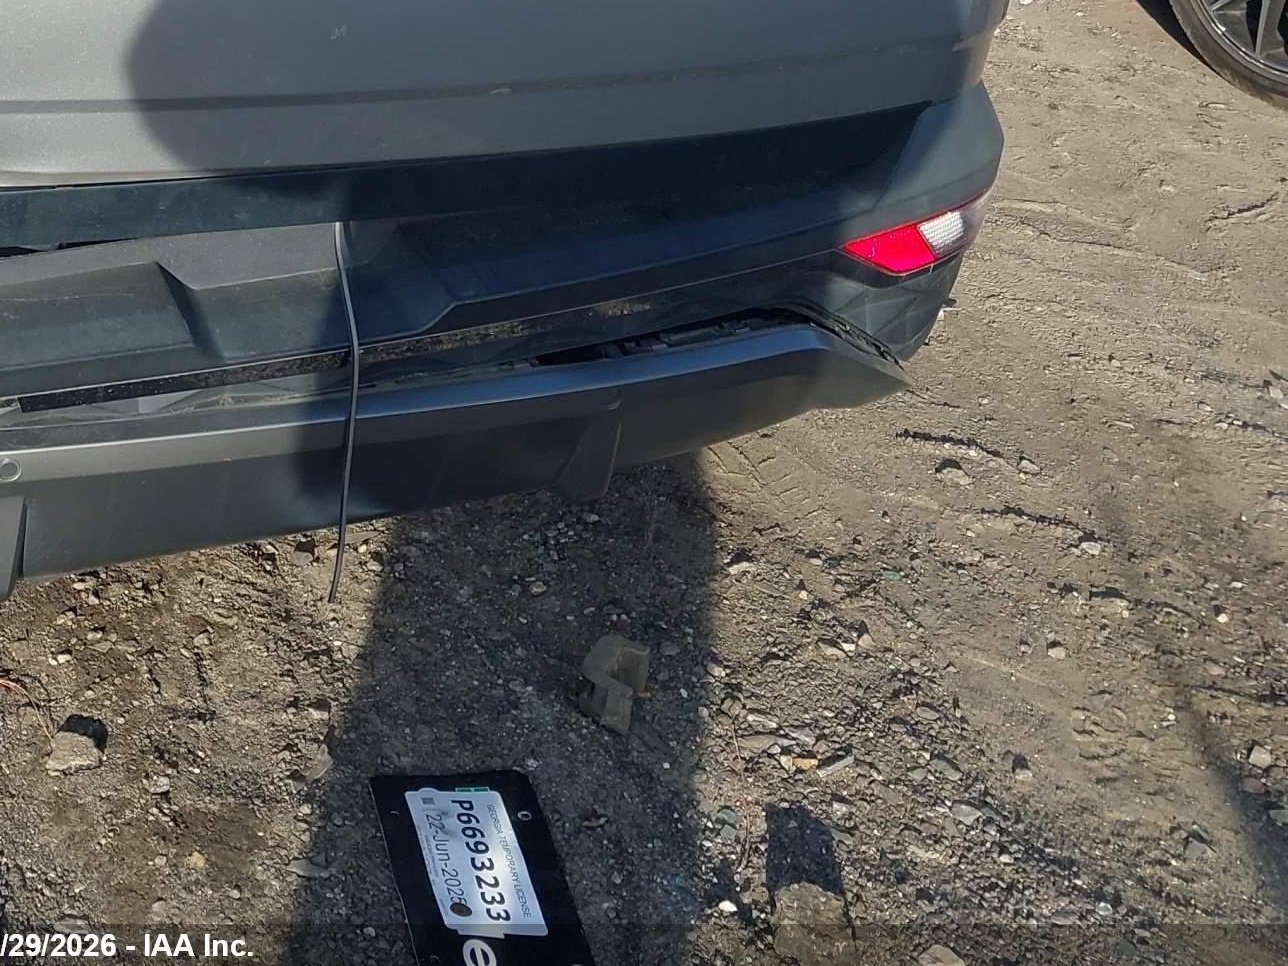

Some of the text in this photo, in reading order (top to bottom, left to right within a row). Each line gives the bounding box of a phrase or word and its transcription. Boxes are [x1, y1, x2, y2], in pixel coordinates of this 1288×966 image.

[451, 799, 511, 922] P6693233
[487, 804, 532, 919] GEORGIA TEMPORARY LICENSE
